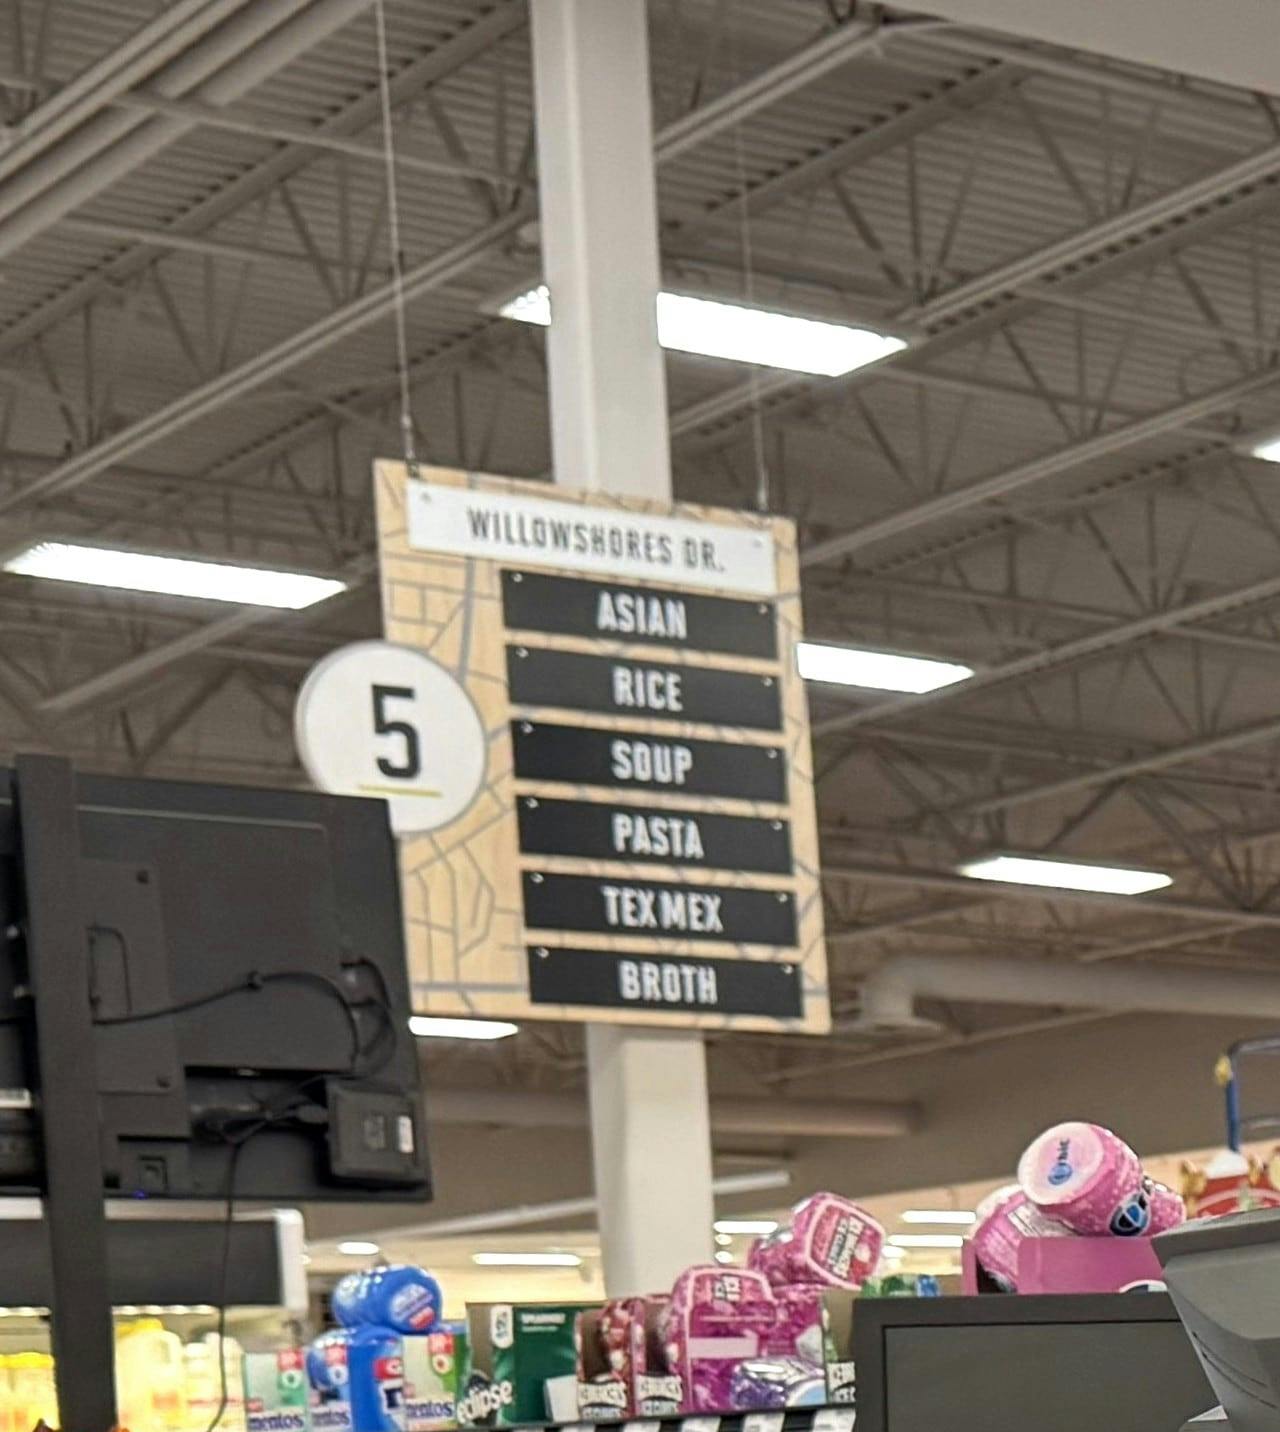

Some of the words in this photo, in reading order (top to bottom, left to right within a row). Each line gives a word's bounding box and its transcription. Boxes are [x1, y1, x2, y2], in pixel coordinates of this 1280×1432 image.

[467, 506, 673, 562] WILLOWSHORES
[683, 537, 726, 573] DR.
[596, 592, 687, 641] ASIAN
[612, 668, 684, 714] RICE
[370, 683, 421, 780] 5
[611, 742, 694, 785] SOUP
[612, 812, 705, 860] PASTA
[619, 960, 718, 1006] BROTH
[457, 1380, 513, 1425] eclipse
